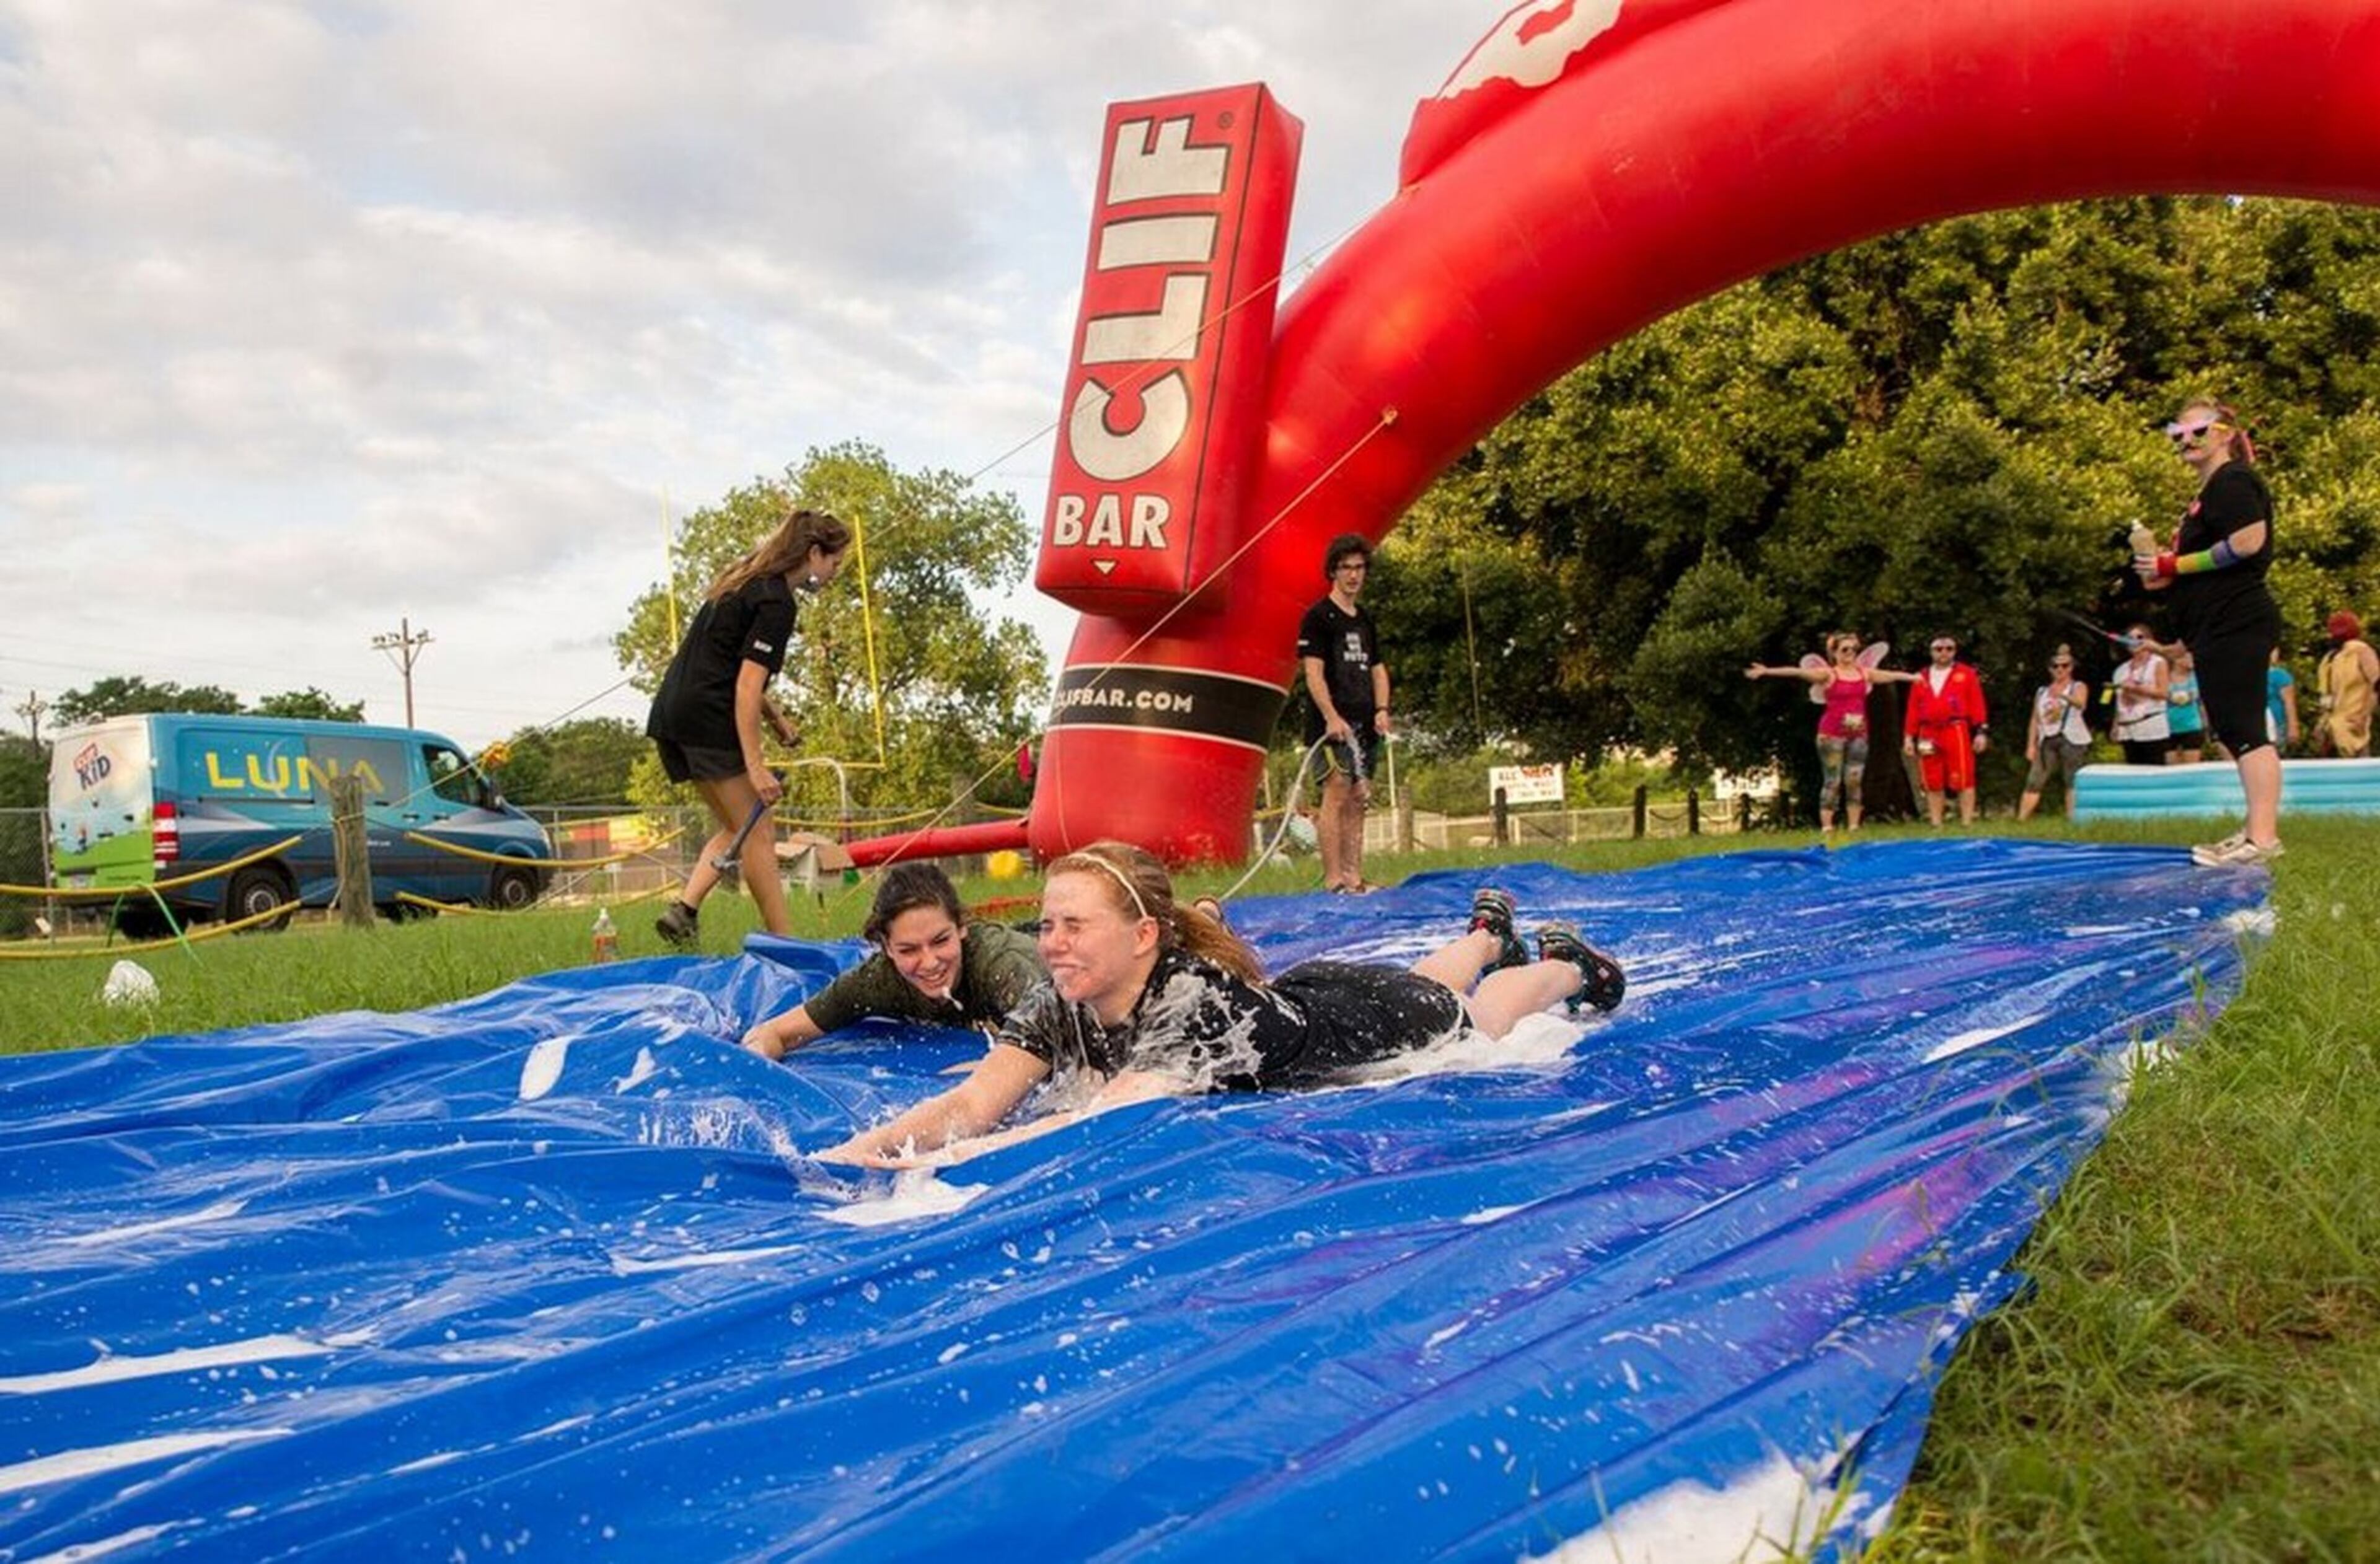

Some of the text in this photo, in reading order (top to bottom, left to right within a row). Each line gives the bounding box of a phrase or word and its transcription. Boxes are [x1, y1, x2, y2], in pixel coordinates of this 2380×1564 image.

[1069, 116, 1230, 481] CLIF
[1052, 494, 1171, 550] BAR
[205, 752, 384, 795] LUNA
